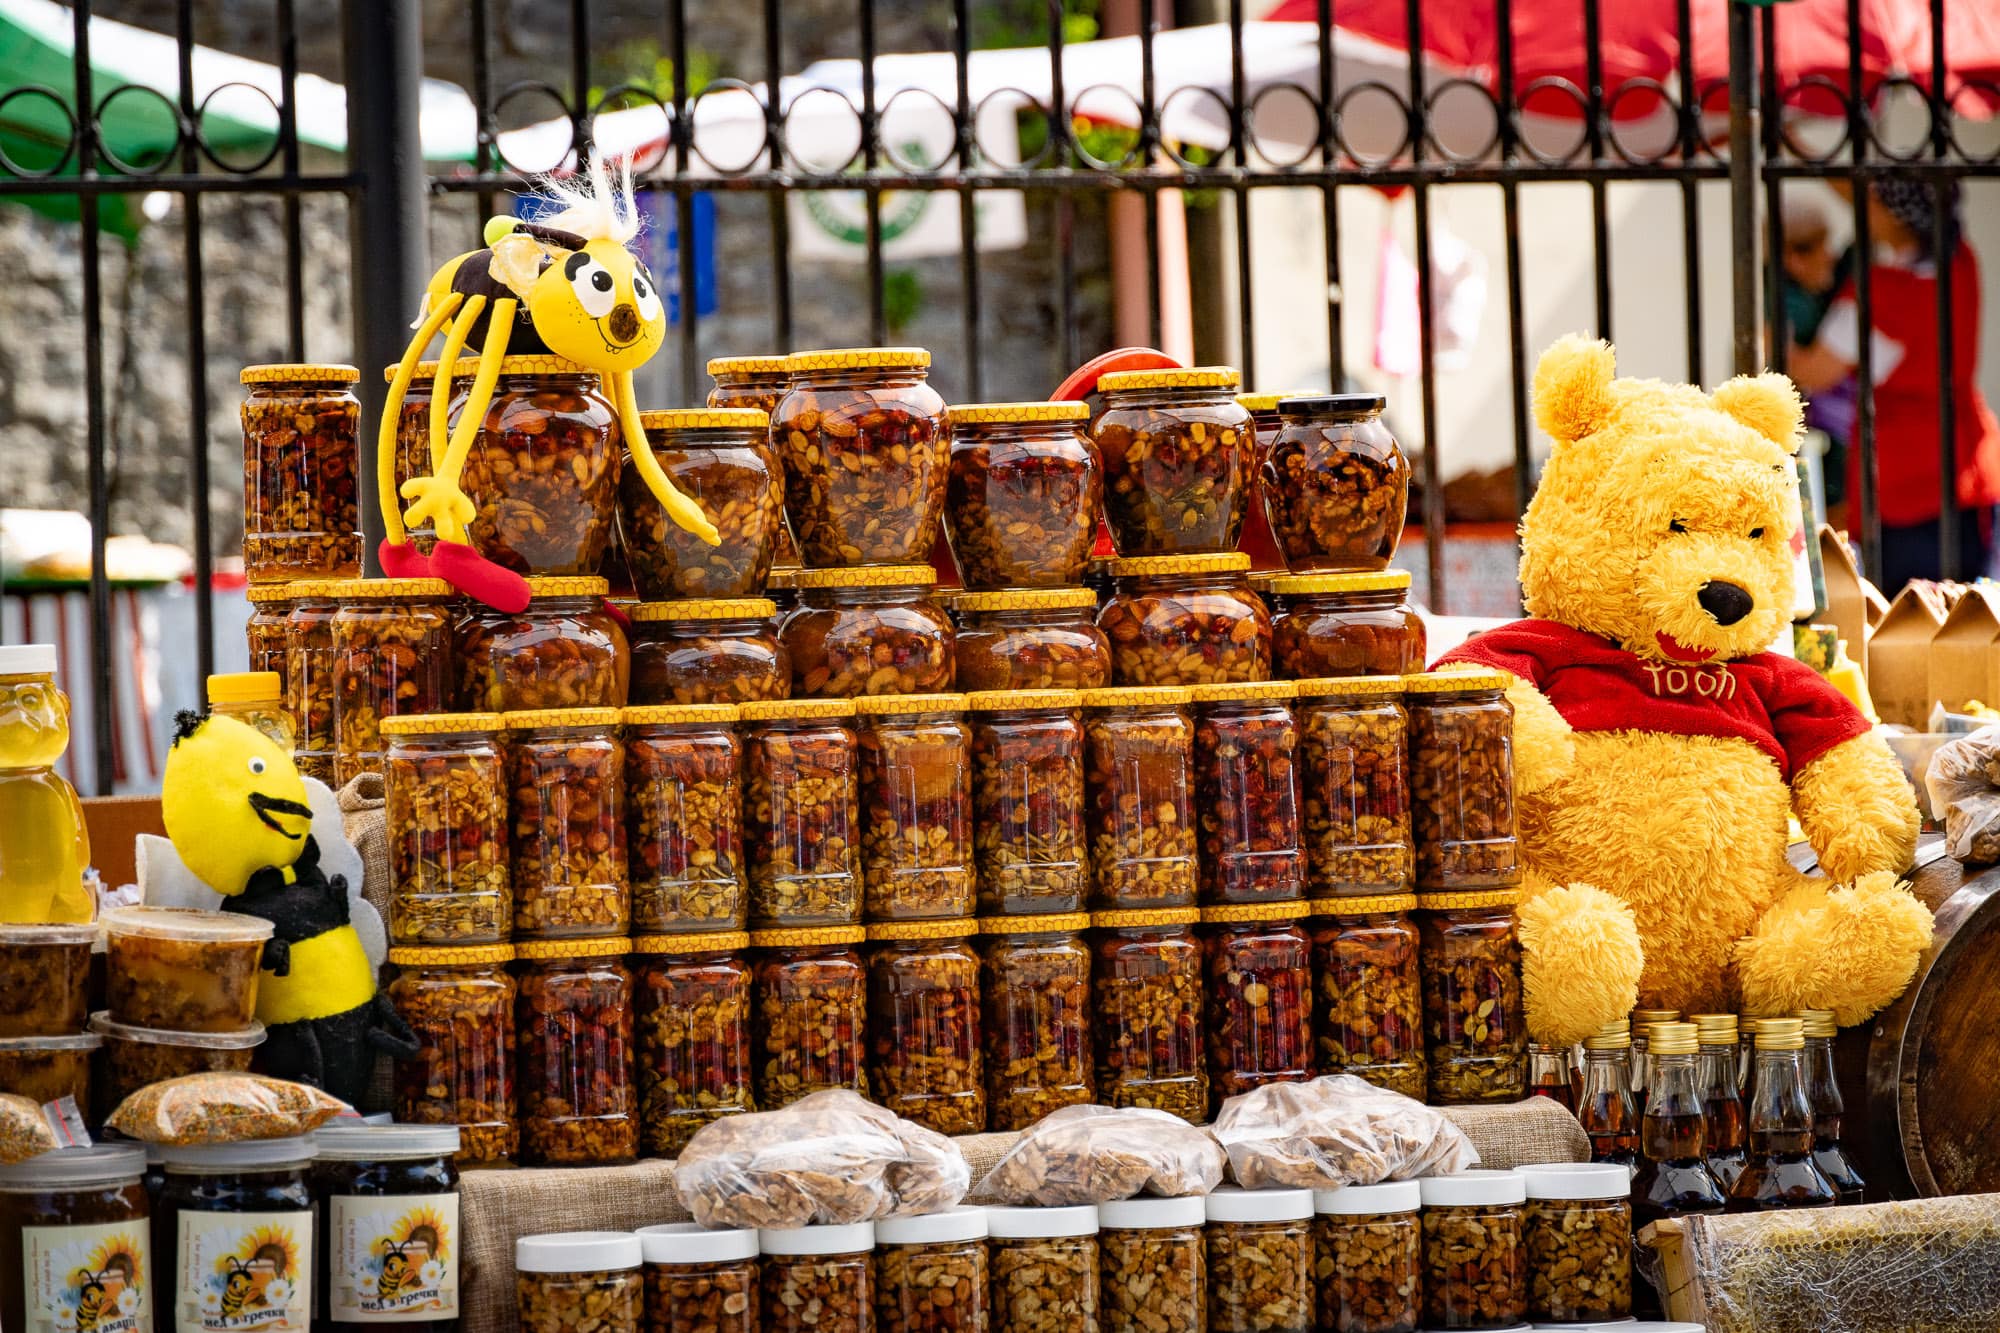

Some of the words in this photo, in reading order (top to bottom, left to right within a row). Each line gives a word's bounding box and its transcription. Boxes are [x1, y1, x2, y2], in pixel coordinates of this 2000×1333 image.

[361, 1297, 384, 1310] мед
[400, 1289, 438, 1305] гречки
[204, 1317, 227, 1328] мед
[243, 1309, 286, 1324] гречки
